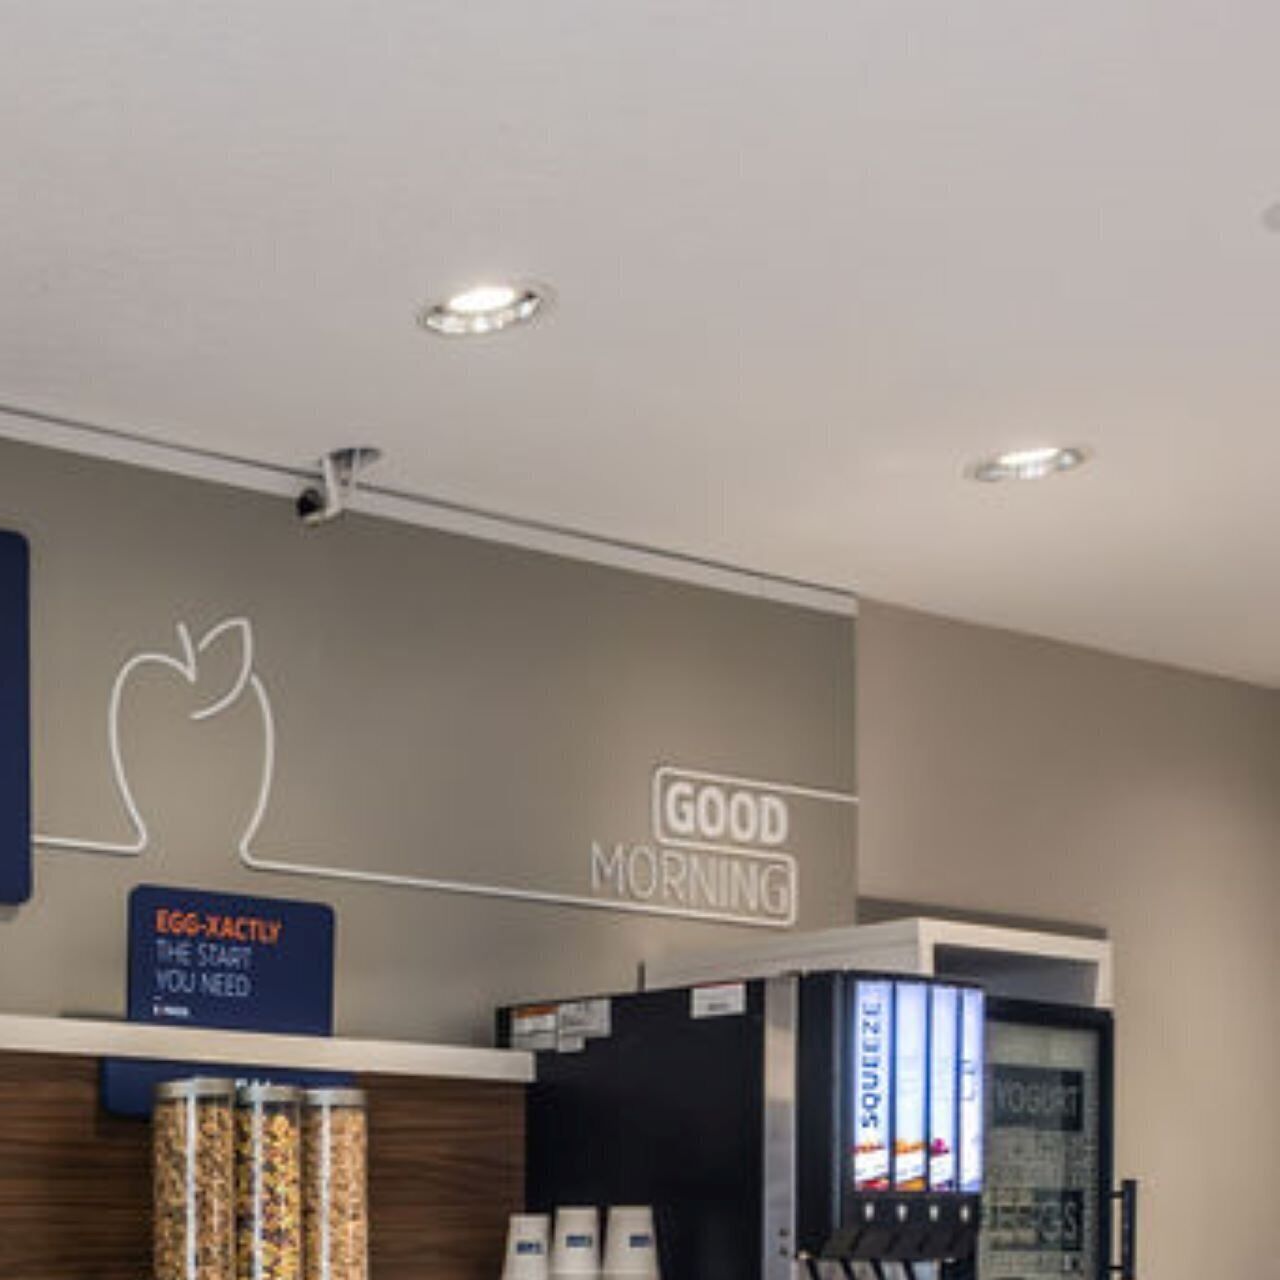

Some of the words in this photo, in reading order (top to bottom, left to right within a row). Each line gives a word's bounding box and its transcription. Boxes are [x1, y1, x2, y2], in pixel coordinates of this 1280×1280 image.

[665, 780, 789, 845] GOOD
[590, 840, 789, 916] MORNING
[155, 907, 282, 945] EGG-XACTLY
[155, 938, 193, 967] THE
[197, 942, 253, 971] START
[155, 968, 196, 994] YOU
[200, 972, 253, 998] NEED
[860, 1002, 882, 1129] SQUEEZE
